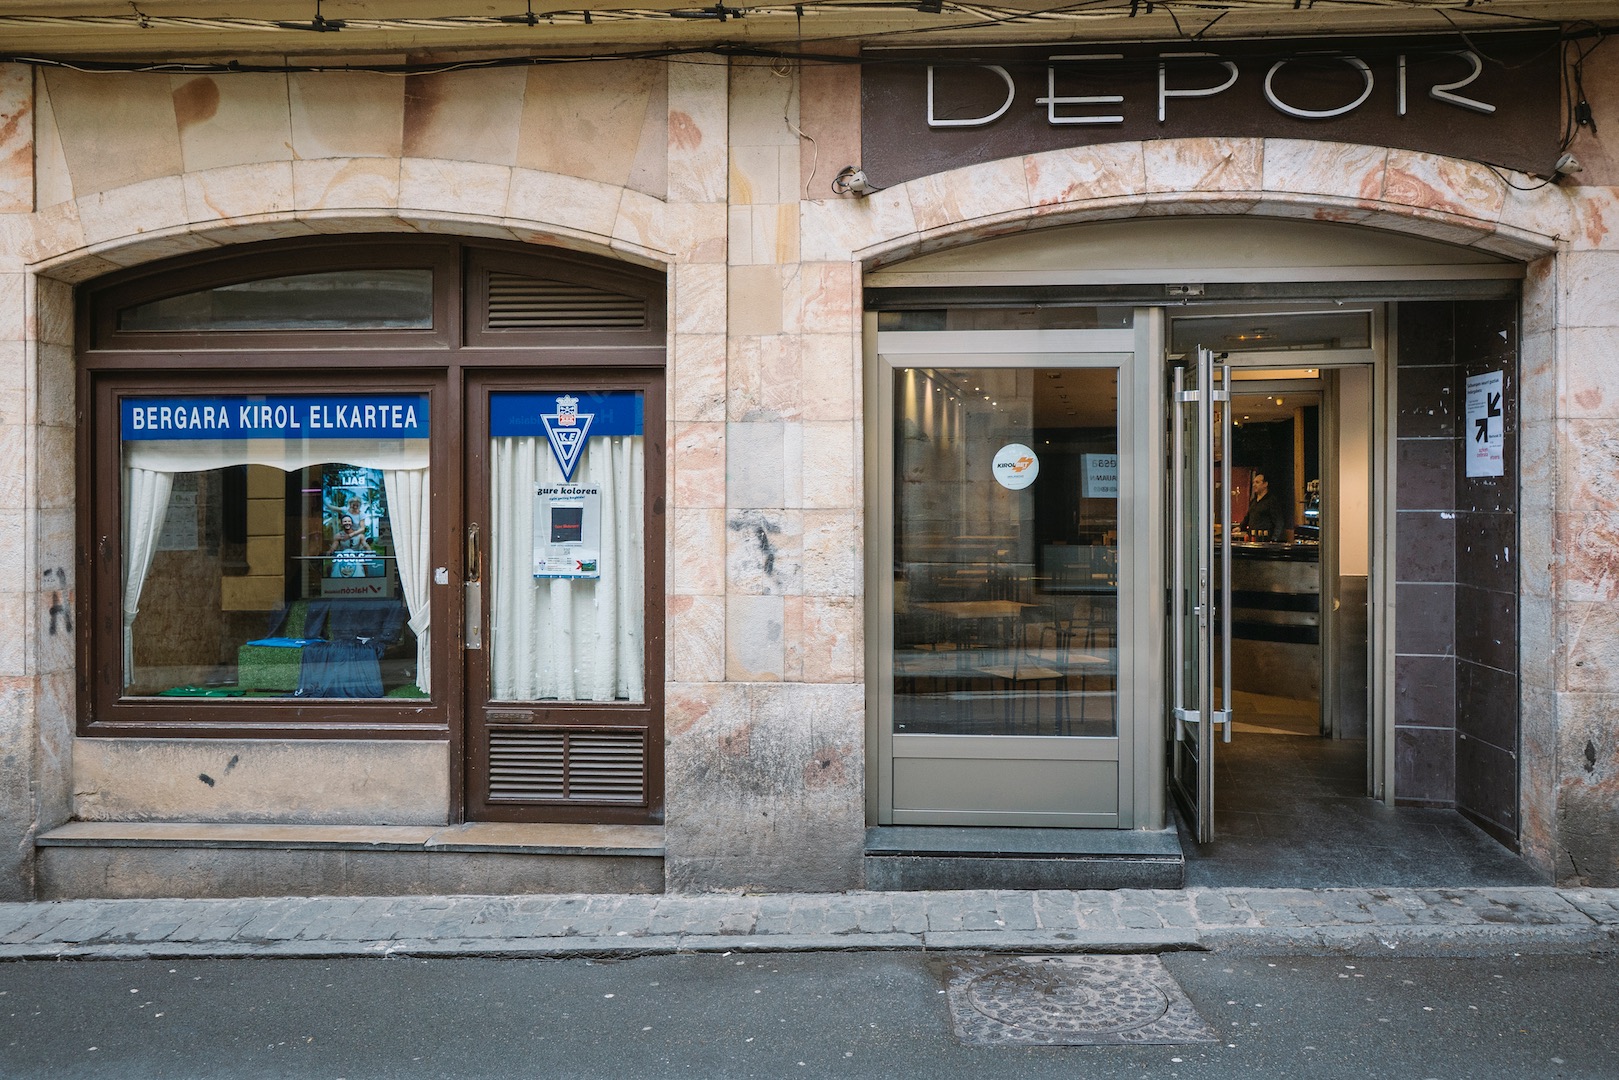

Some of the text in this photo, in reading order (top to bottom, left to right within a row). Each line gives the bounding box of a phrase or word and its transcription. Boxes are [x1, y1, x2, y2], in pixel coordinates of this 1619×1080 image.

[926, 50, 1497, 128] DEPOR
[132, 404, 418, 430] BERGARA KIROL ELKARTEA
[537, 486, 597, 496] gure kolorea
